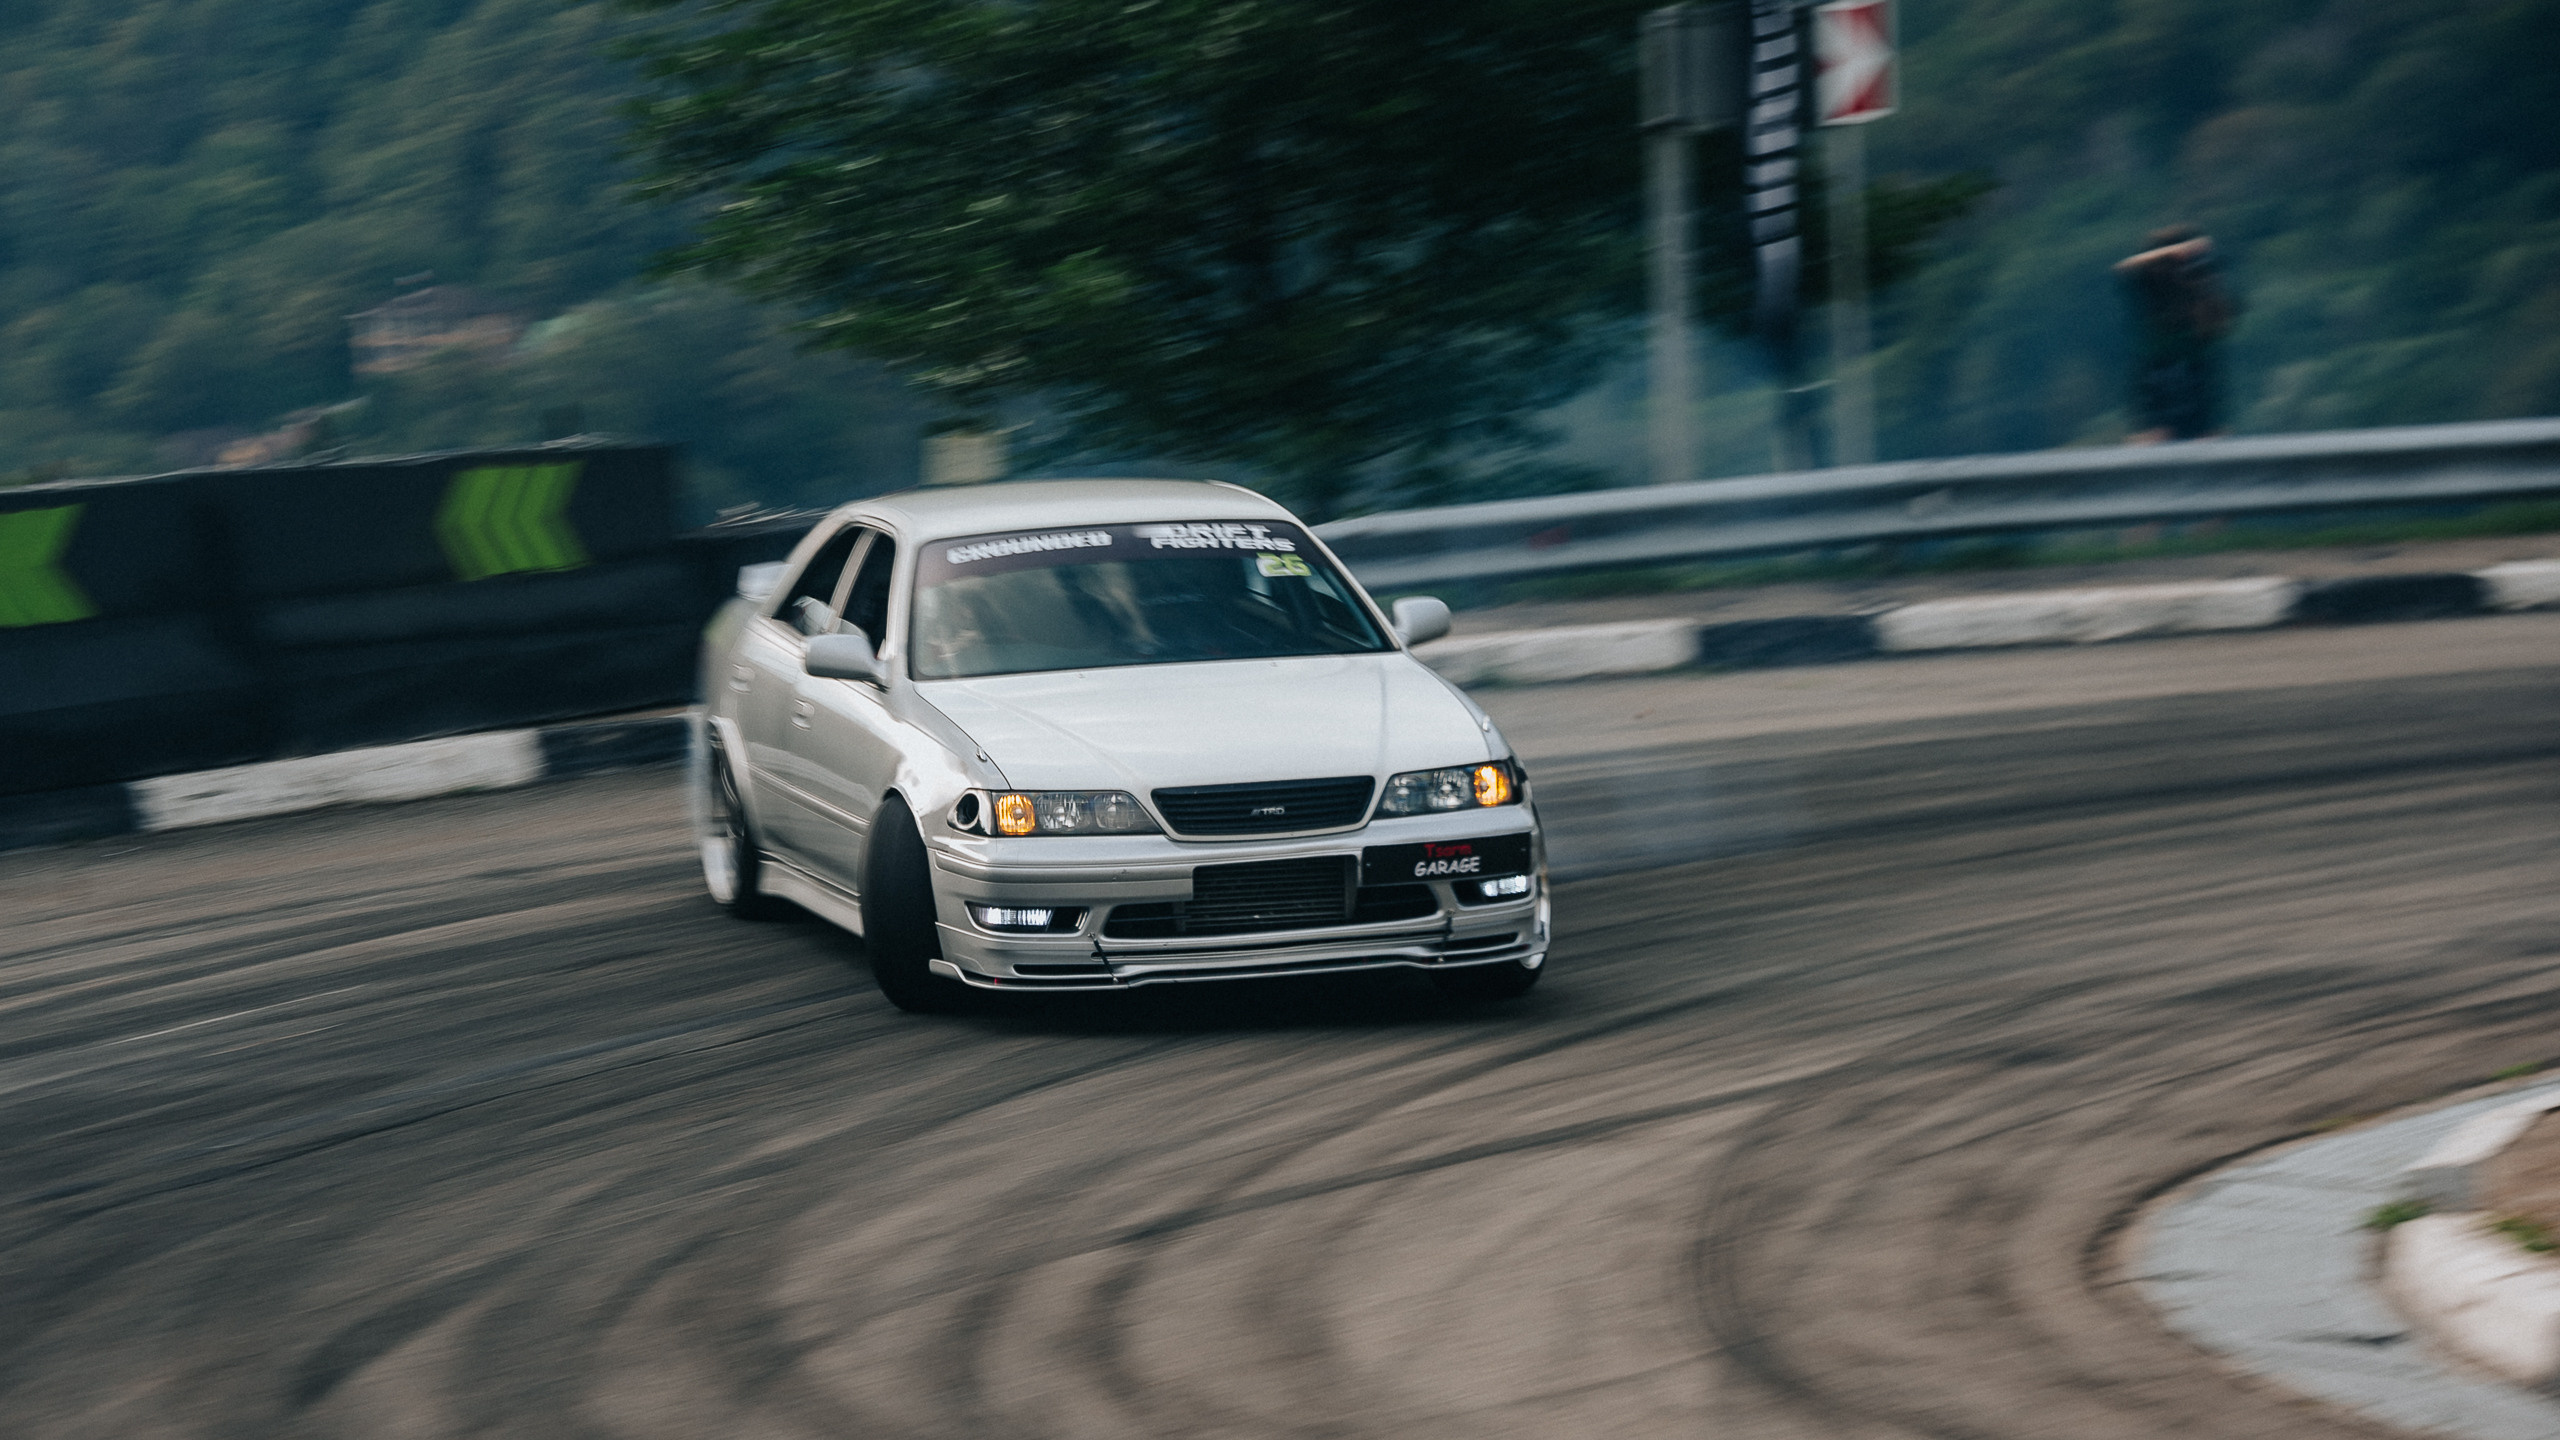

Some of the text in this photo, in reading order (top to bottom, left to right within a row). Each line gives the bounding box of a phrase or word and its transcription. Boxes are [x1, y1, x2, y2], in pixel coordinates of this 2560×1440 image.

[1151, 522, 1271, 539] DRIFT
[1150, 536, 1296, 551] FIGHTERS
[1255, 552, 1312, 577] 26
[1260, 806, 1285, 815] TRD
[1414, 856, 1481, 877] GARAGE
